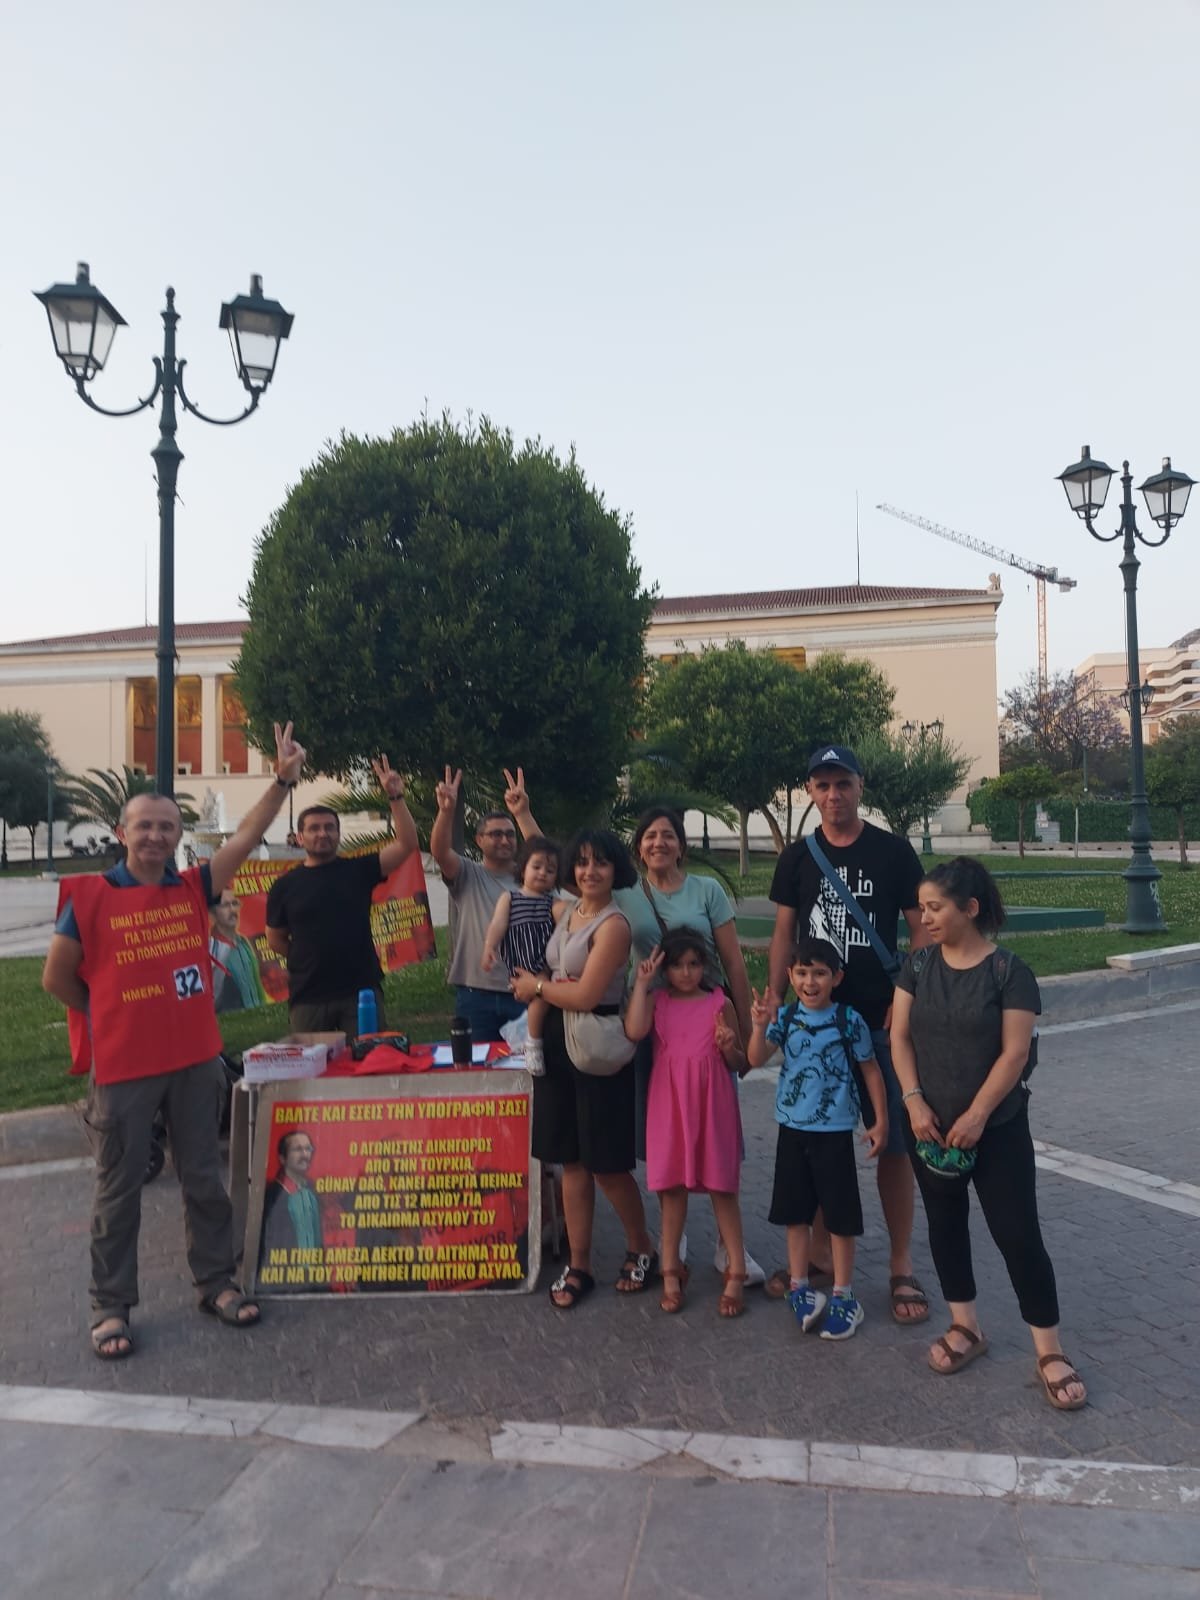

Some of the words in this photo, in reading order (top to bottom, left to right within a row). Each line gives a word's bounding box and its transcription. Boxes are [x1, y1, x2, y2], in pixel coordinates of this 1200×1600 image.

[175, 967, 203, 997] 32
[275, 1106, 319, 1124] ΒΑΛΤΕ
[322, 1105, 346, 1122] ΚΑΙ
[349, 1103, 383, 1121] ΕΣΕΙΣ
[386, 1103, 414, 1120] ΤΗΝ
[418, 1100, 495, 1119] ΥΠΟΓΡΑΦΗ
[498, 1099, 527, 1116] ΣΑΣ!
[426, 1137, 492, 1154] ΔΙΚΗΓΟΡΟΣ
[365, 1158, 390, 1173] ΑΠΟ
[393, 1158, 417, 1173] ΤΗΝ
[388, 1175, 425, 1191] ΚΑΝΕΙ
[427, 1174, 478, 1190] ΑΠΕΡΓΙΑ
[480, 1173, 523, 1188] ΠΕΙΝΑΣ
[354, 1194, 380, 1210] ΑΠΟ
[383, 1193, 400, 1209] ΤΙΣ
[403, 1193, 418, 1209] 12
[463, 1191, 482, 1207] ΓΙΑ
[340, 1212, 356, 1229] ΤΟ
[358, 1211, 420, 1228] ΔΙΚΑΙΩΜΑ
[422, 1210, 469, 1227] ΑΣΥΛΟΥ
[472, 1209, 496, 1226] ΤΟΥ
[270, 1248, 287, 1265] ΝΑ
[290, 1247, 323, 1265] ΓΙΝΕΙ
[325, 1247, 369, 1264] ΑΜΕΣΑ
[371, 1246, 414, 1263] ΔΕΚΤΟ
[416, 1246, 433, 1262] ΤΟ
[436, 1244, 489, 1261] ΑΙΤΗΜΑ
[492, 1243, 517, 1260] ΤΟΥ
[261, 1266, 284, 1284] ΚΑΙ
[286, 1266, 305, 1284] ΝΑ
[308, 1265, 333, 1283] ΤΟΥ
[335, 1264, 409, 1282] ΧΟΡΗΓΗΘΕΙ
[411, 1262, 476, 1281] ΠΟΛΙΤΙΚΟ
